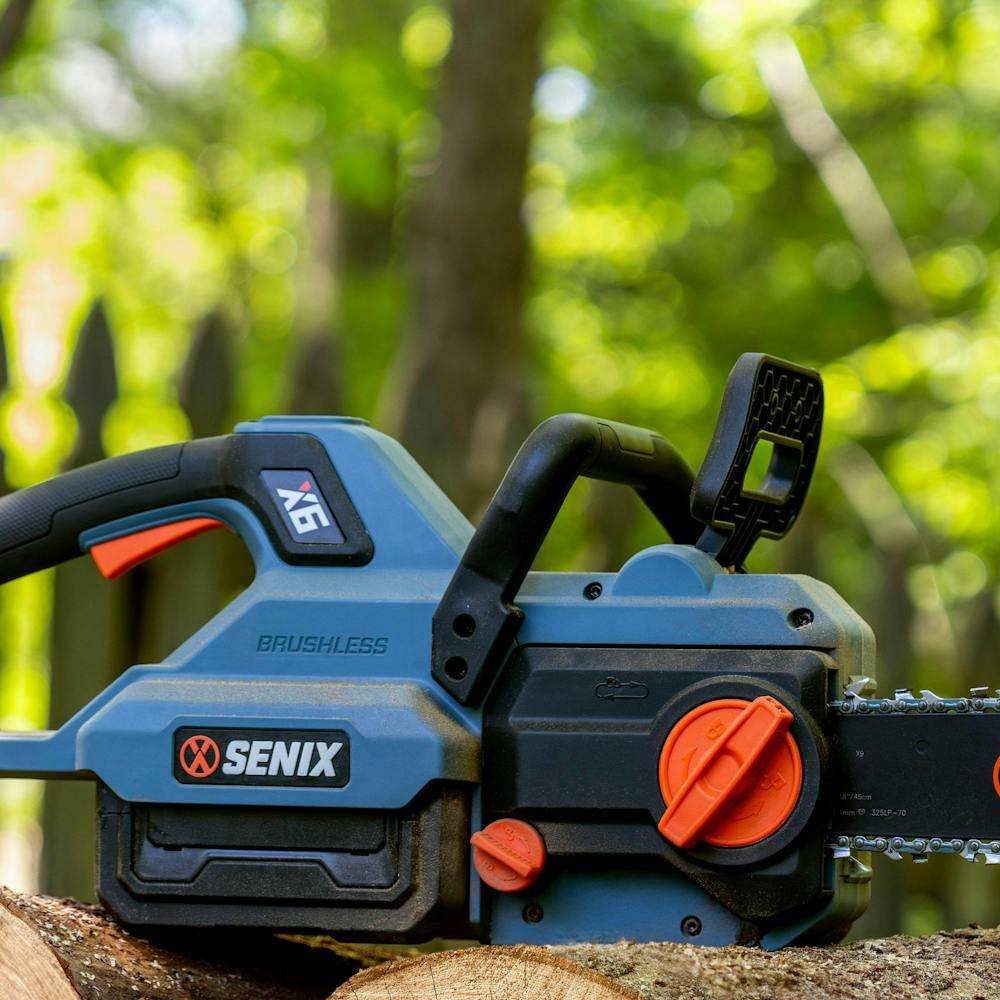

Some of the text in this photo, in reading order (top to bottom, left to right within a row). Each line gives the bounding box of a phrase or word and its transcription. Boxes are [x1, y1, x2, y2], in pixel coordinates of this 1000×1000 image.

[276, 481, 330, 534] X6
[256, 634, 389, 655] BRUSHLESS
[222, 740, 344, 777] SENIX
